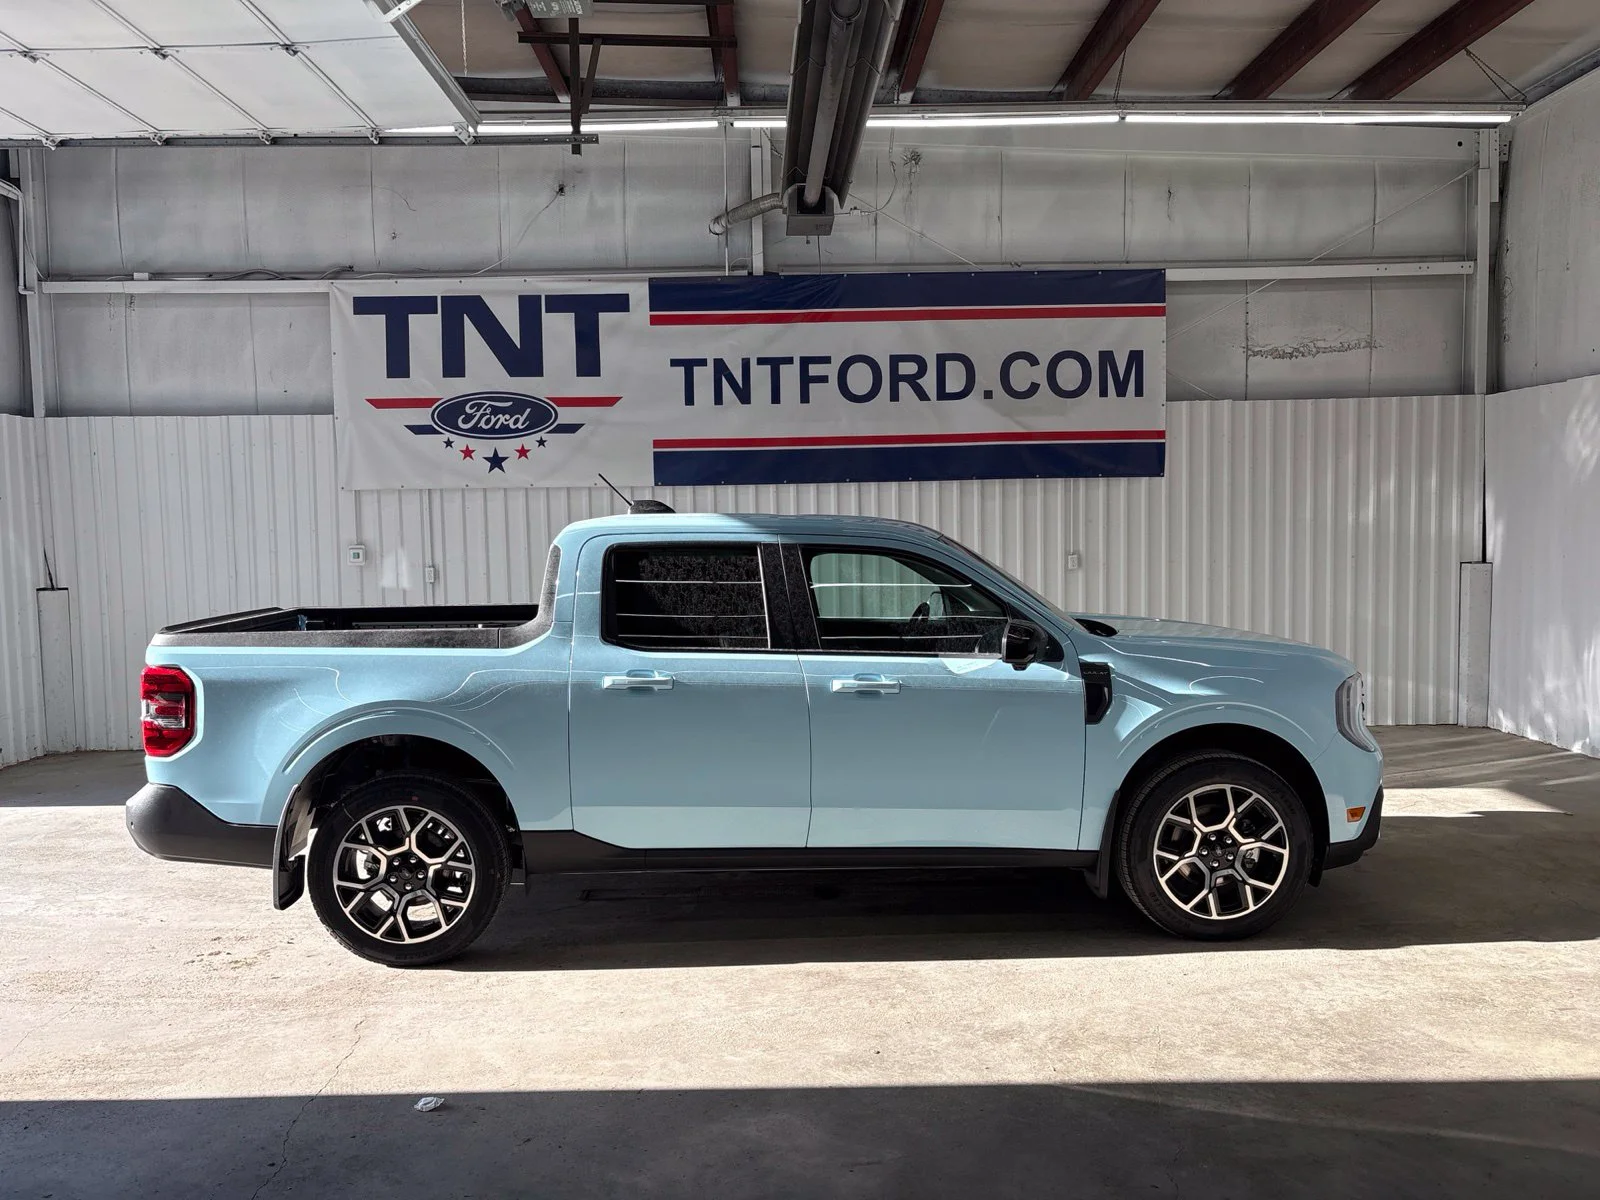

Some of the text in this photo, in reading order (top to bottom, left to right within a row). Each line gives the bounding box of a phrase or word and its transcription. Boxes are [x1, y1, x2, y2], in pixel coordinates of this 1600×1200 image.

[353, 293, 630, 379] TNT
[669, 349, 1145, 406] TNTFORD.COM
[457, 399, 531, 430] Ford
